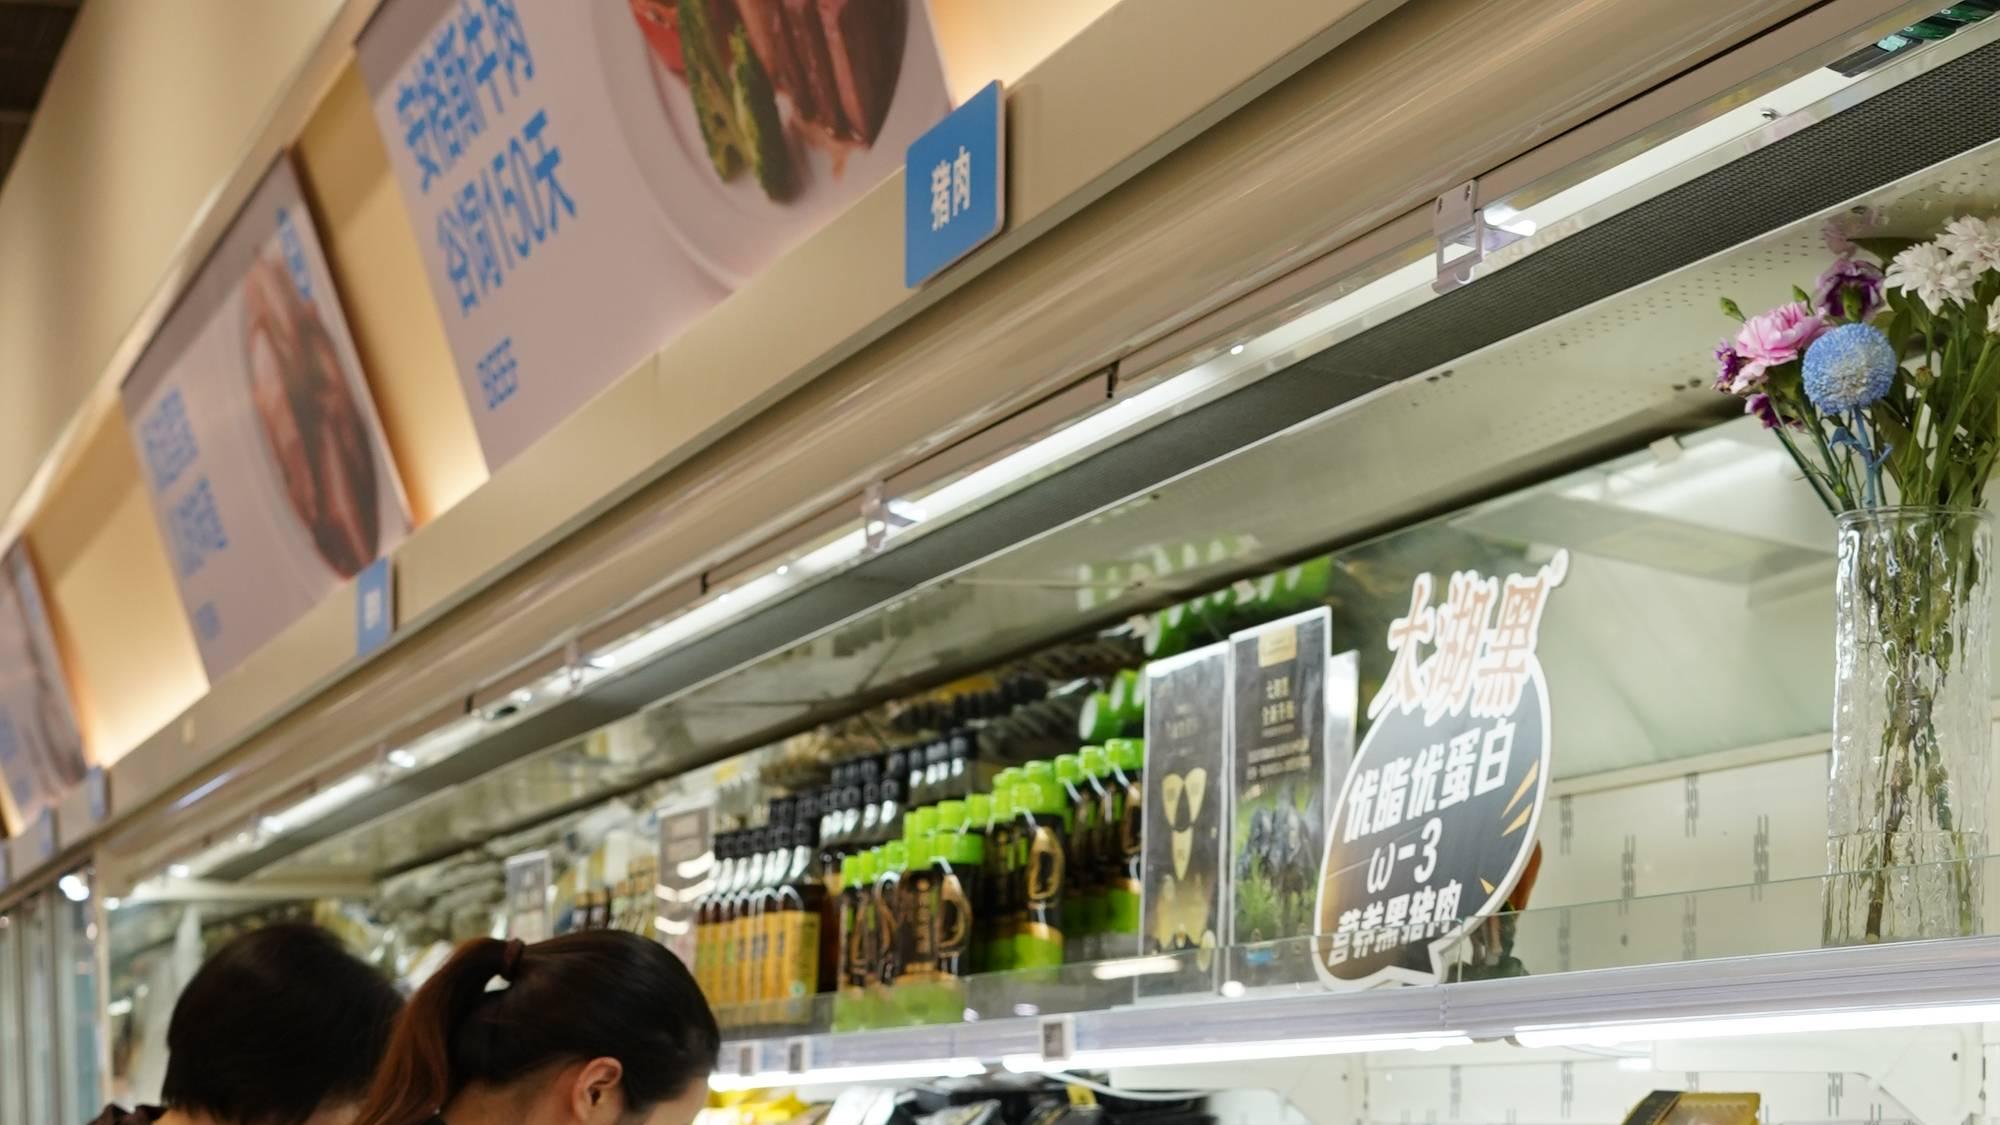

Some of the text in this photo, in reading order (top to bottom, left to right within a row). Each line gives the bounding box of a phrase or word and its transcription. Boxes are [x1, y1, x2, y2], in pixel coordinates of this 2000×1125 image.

[396, 0, 534, 194] 安格斯牛肉
[437, 108, 575, 318] 谷饲150天
[930, 144, 972, 233] 猪肉
[476, 336, 518, 410] BEEF
[1372, 570, 1551, 724] 太湖黑
[1343, 717, 1516, 844] 优脂优蛋白
[1327, 878, 1463, 967] 营养黑猪肉
